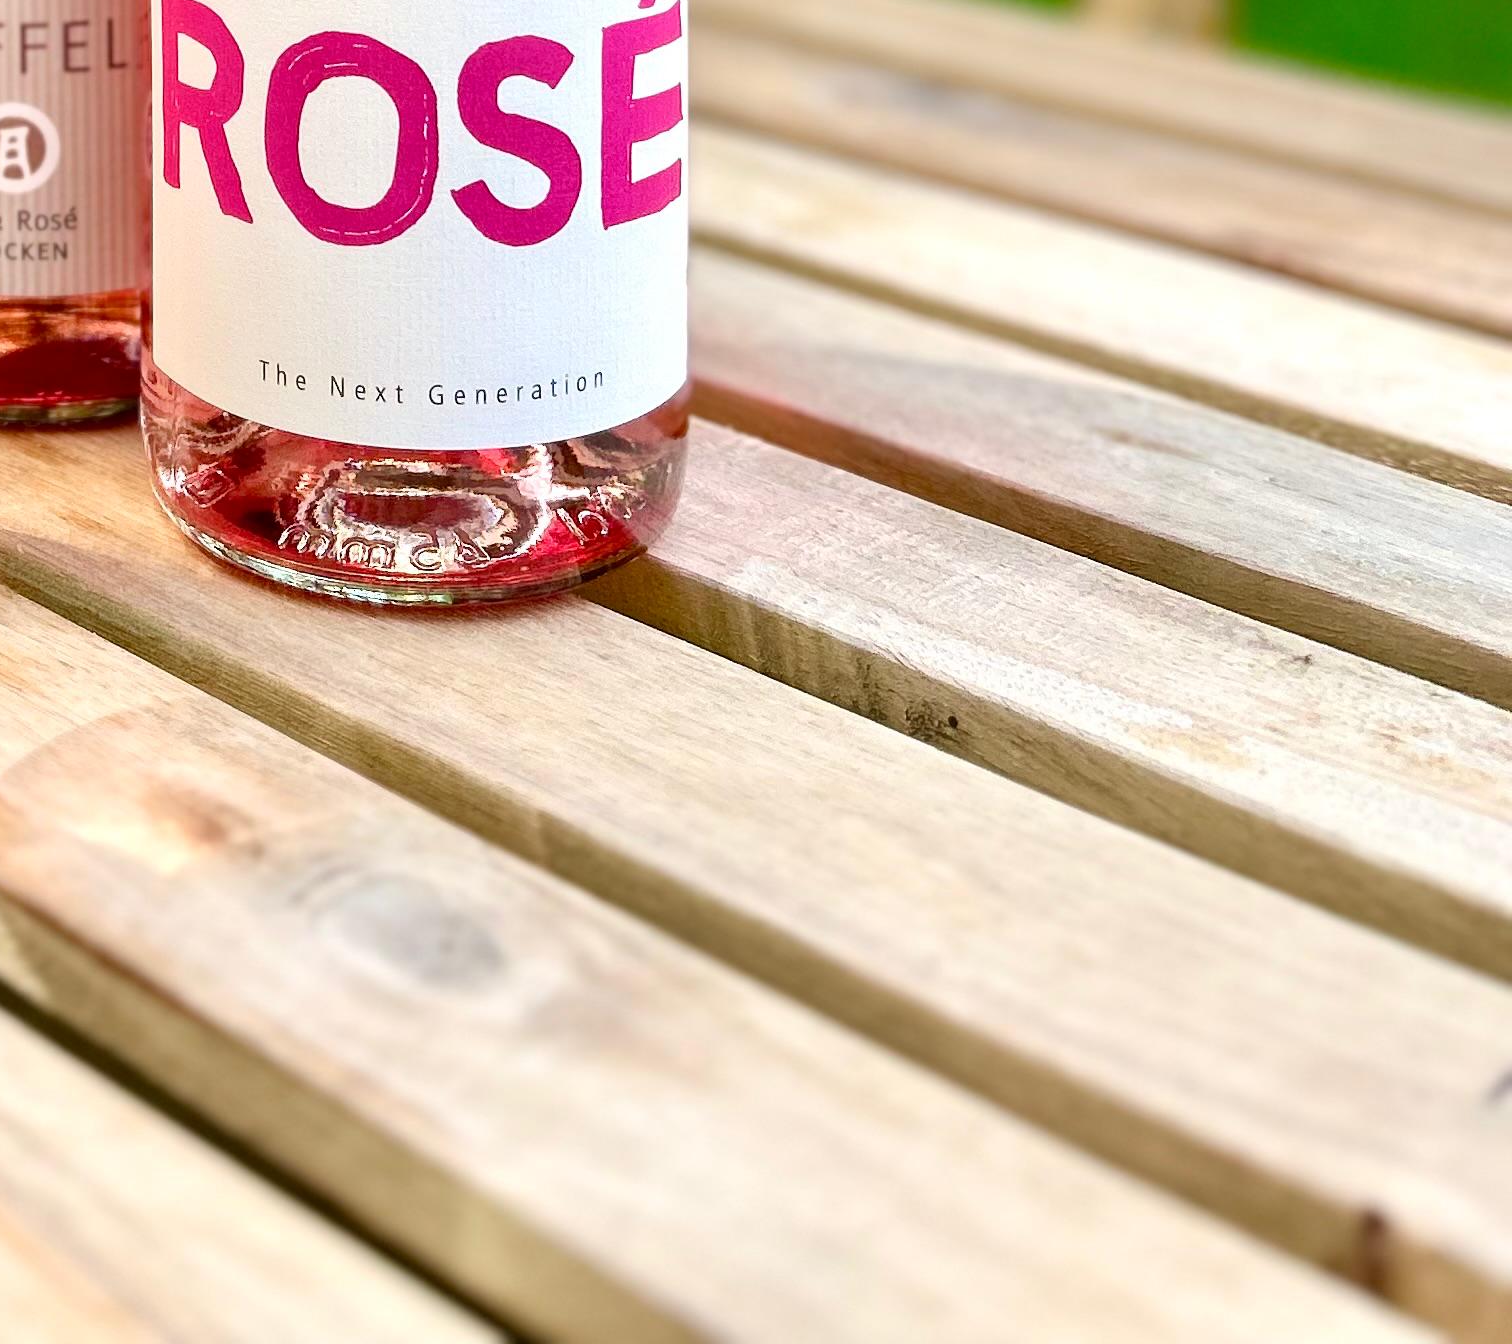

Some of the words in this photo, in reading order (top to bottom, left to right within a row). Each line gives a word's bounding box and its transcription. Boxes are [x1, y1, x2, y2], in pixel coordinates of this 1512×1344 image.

[17, 206, 78, 231] Rosé
[258, 359, 308, 392] The
[330, 374, 405, 405] Next
[427, 368, 606, 407] Generation
